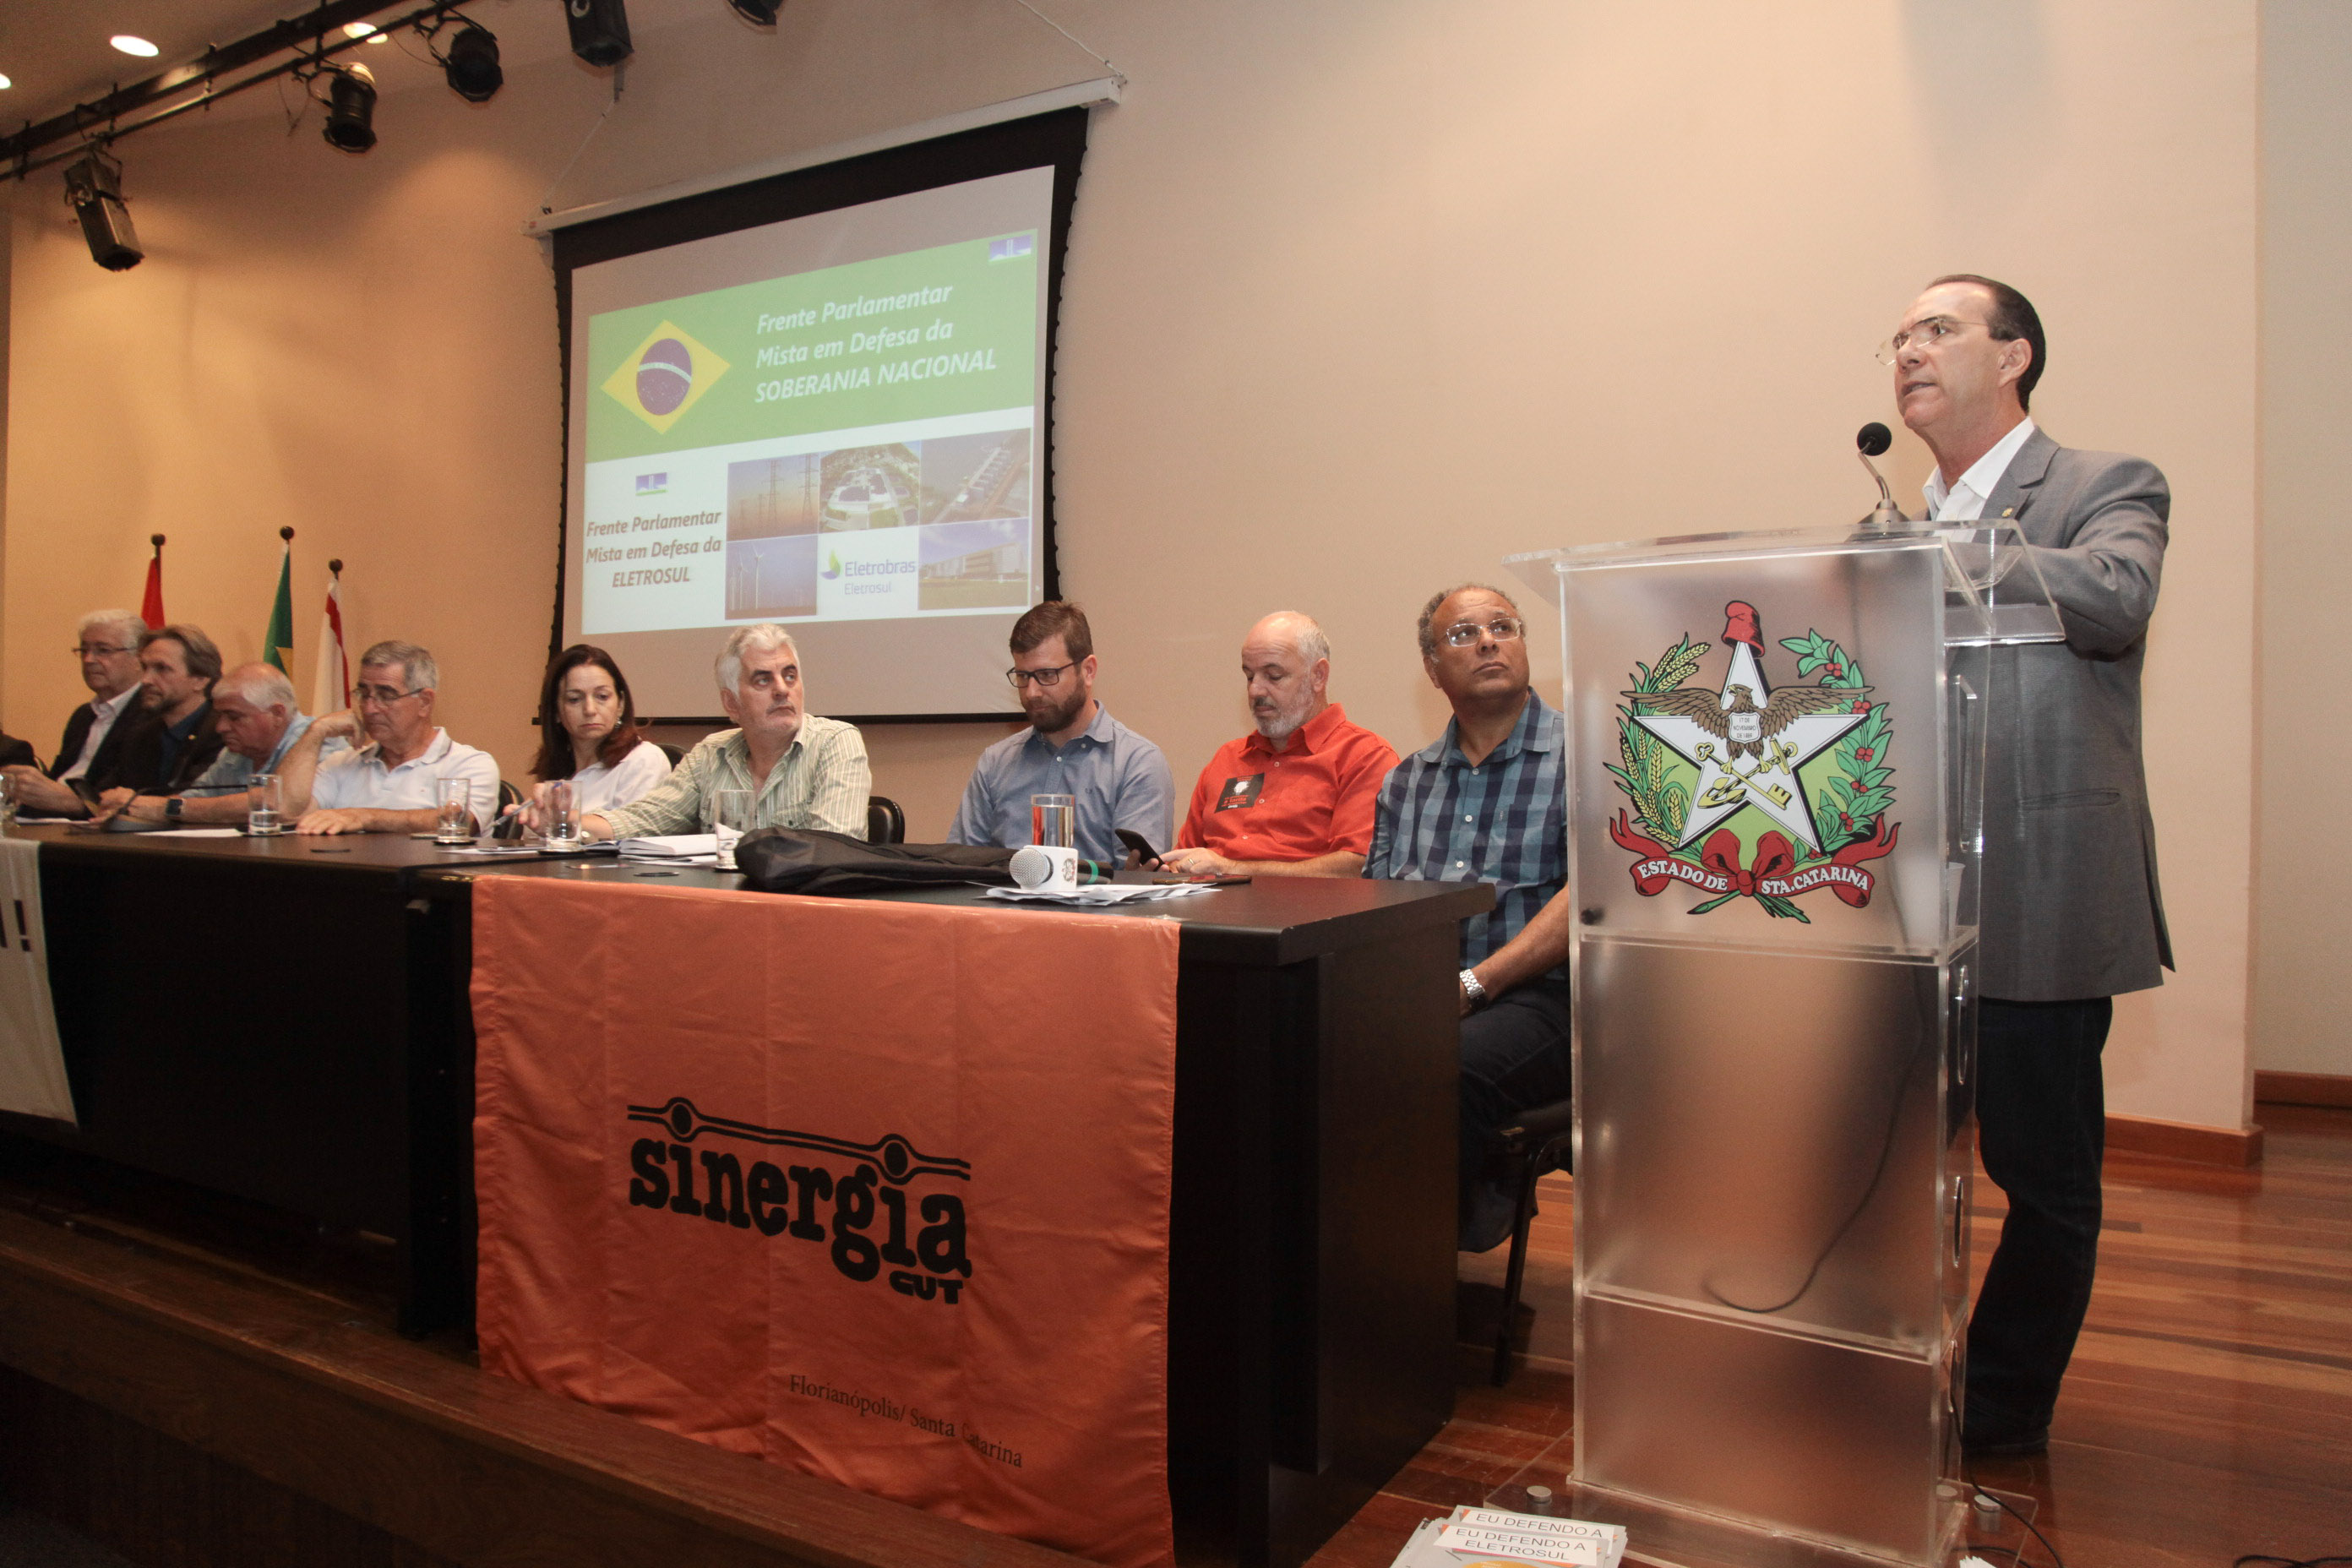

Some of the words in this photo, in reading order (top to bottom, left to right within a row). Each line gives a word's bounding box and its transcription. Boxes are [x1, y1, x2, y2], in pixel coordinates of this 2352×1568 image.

[756, 313, 816, 335] Frente
[821, 286, 953, 323] Parlamentar
[756, 346, 808, 368] Mista
[814, 340, 843, 359] em
[849, 326, 919, 354] Defesa
[925, 318, 954, 341] da
[754, 367, 871, 403] SOBERANIA
[878, 348, 997, 385] NACIONAL
[586, 520, 628, 536] Frente
[631, 510, 721, 532] Parlamentar
[585, 546, 623, 564] Mista
[626, 546, 648, 559] em
[651, 539, 699, 559] Defesa
[703, 536, 722, 553] da
[612, 567, 690, 588] ELETROSUL
[844, 558, 917, 577] Eletrobras
[844, 581, 892, 595] Eletrosul
[1637, 860, 1704, 884] ESTADO
[1704, 877, 1728, 890] DE
[629, 1137, 972, 1282] sinergia
[889, 1270, 964, 1305] CUT
[789, 1375, 906, 1423] Florianópolis/
[910, 1407, 956, 1437] Santa
[1456, 1528, 1479, 1538] EU
[1484, 1532, 1571, 1549] DEFENDO
[1574, 1542, 1587, 1551] A
[1476, 1513, 1500, 1523] EU
[1504, 1517, 1587, 1536] DEFENDO
[1591, 1528, 1603, 1538] A
[1465, 1539, 1570, 1561] ELETROSUL
